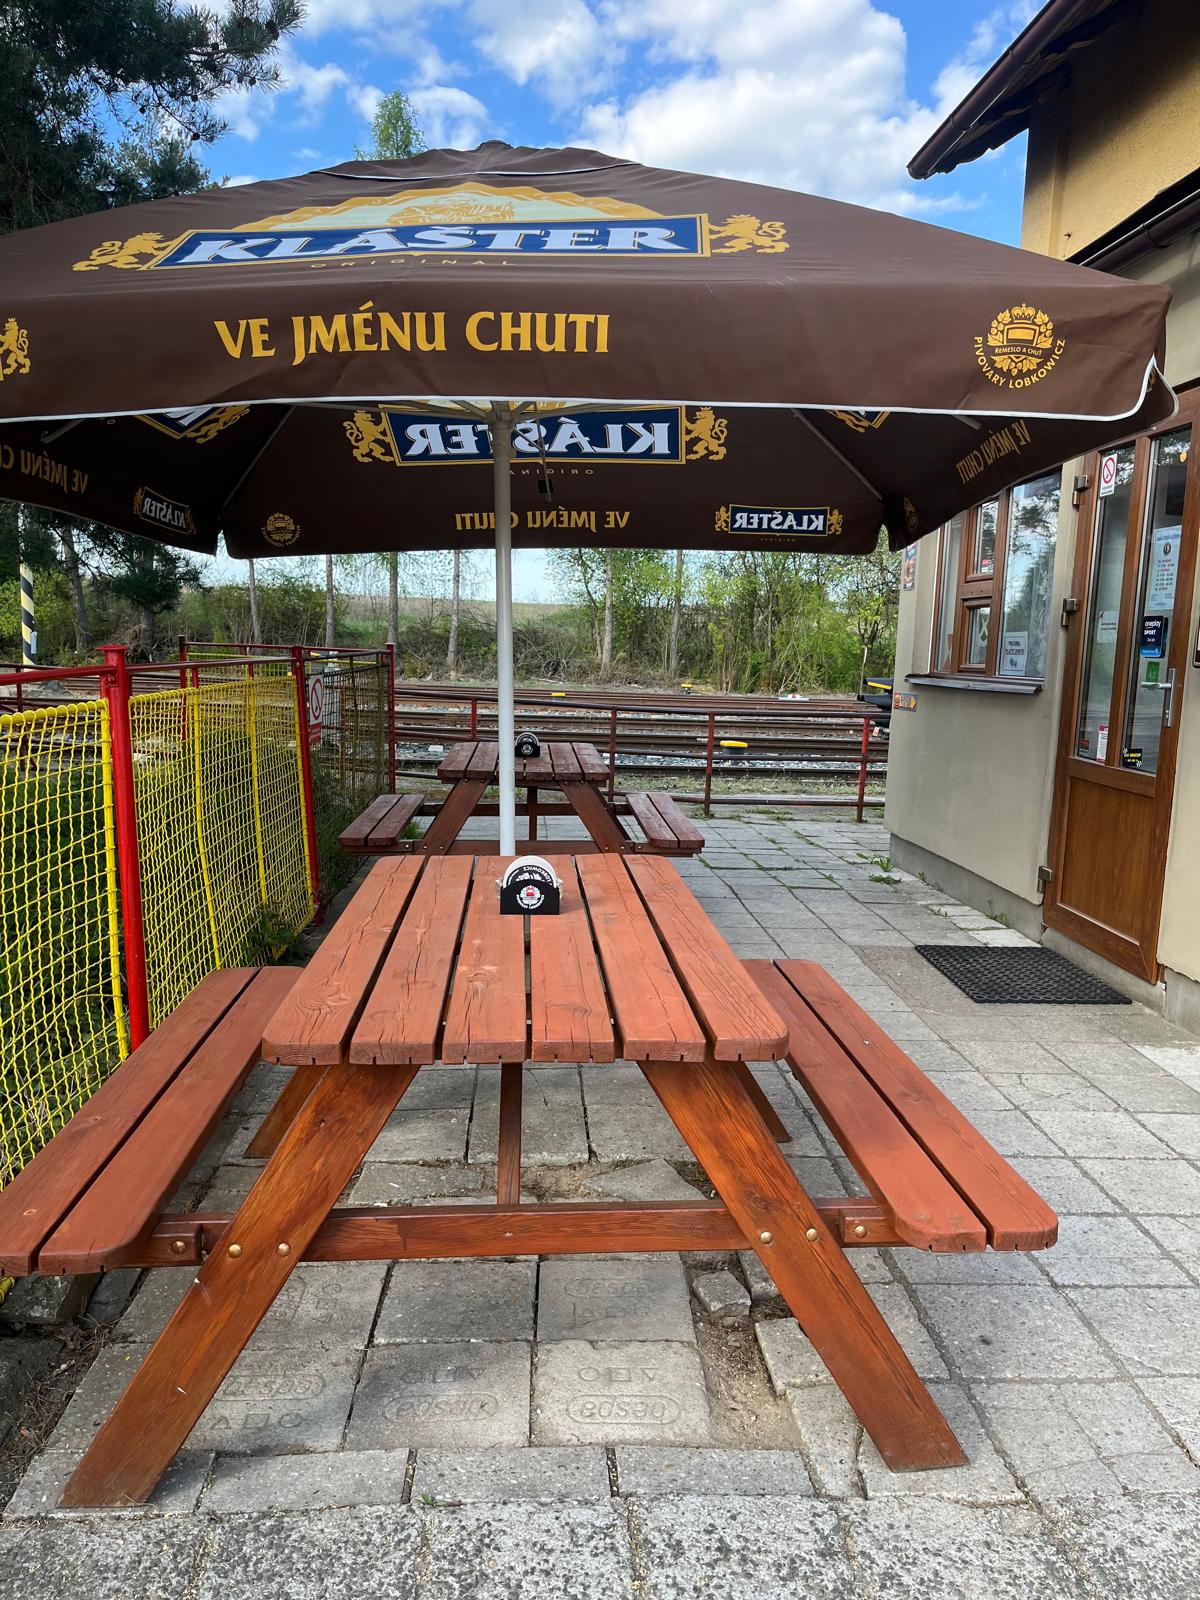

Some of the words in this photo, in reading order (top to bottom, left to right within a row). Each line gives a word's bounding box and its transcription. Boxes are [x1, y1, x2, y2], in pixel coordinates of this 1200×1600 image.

[176, 227, 690, 263] KLÁŠTER
[310, 257, 515, 269] ORIGINAL
[214, 317, 275, 360] VE
[290, 300, 448, 366] JMÉNU
[465, 311, 610, 353] CHUTI
[974, 336, 1006, 386] PIVOVARY
[1009, 339, 1066, 388] LOBKOWICZ
